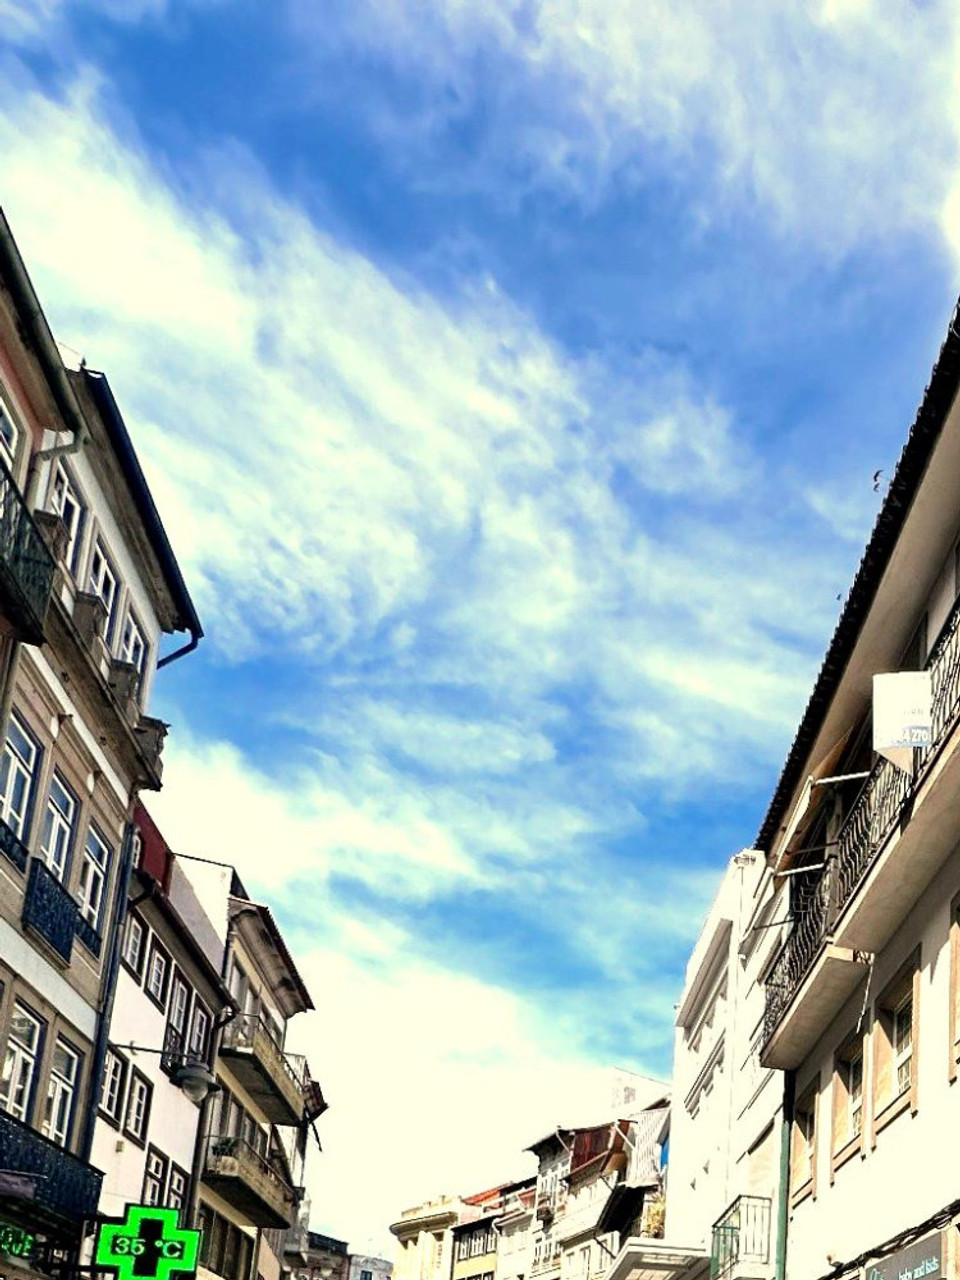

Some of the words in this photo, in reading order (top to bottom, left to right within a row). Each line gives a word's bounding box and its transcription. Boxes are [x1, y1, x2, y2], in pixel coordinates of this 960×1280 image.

[115, 1237, 146, 1255] 35
[154, 1240, 182, 1258] °C
[913, 1260, 926, 1279] and
[925, 1255, 939, 1275] kids
